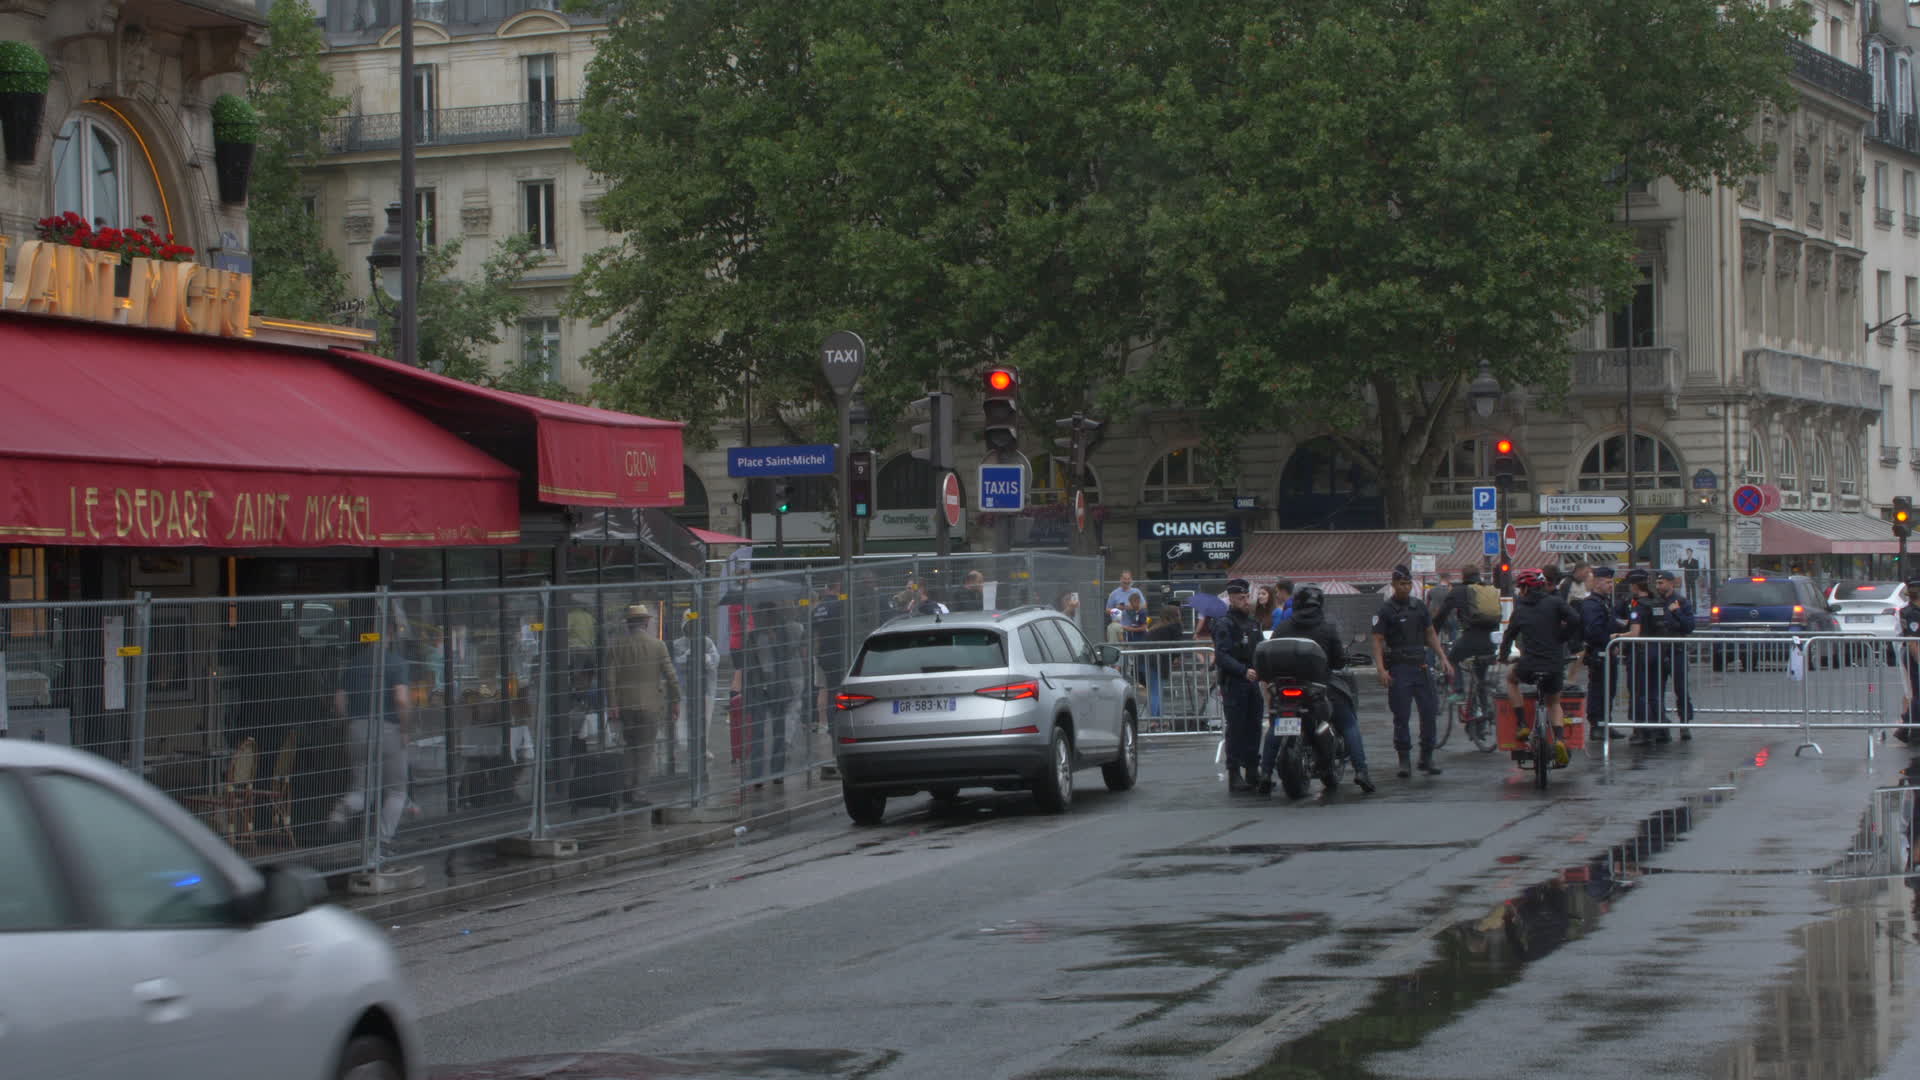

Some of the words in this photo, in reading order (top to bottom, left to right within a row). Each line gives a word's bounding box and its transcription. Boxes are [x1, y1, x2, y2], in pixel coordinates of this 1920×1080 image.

[824, 349, 858, 364] TAXI
[625, 451, 656, 477] GROM
[737, 457, 763, 468] Place
[765, 454, 826, 467] Saint-Michel
[984, 481, 1018, 495] TAXIS
[1479, 492, 1490, 507] P
[71, 487, 99, 539] LE
[226, 493, 289, 540] SAINT
[303, 496, 376, 541] MICHEL
[1152, 521, 1227, 536] CHANGE
[1202, 541, 1235, 549] RETRAIT
[1208, 552, 1230, 560] CASH
